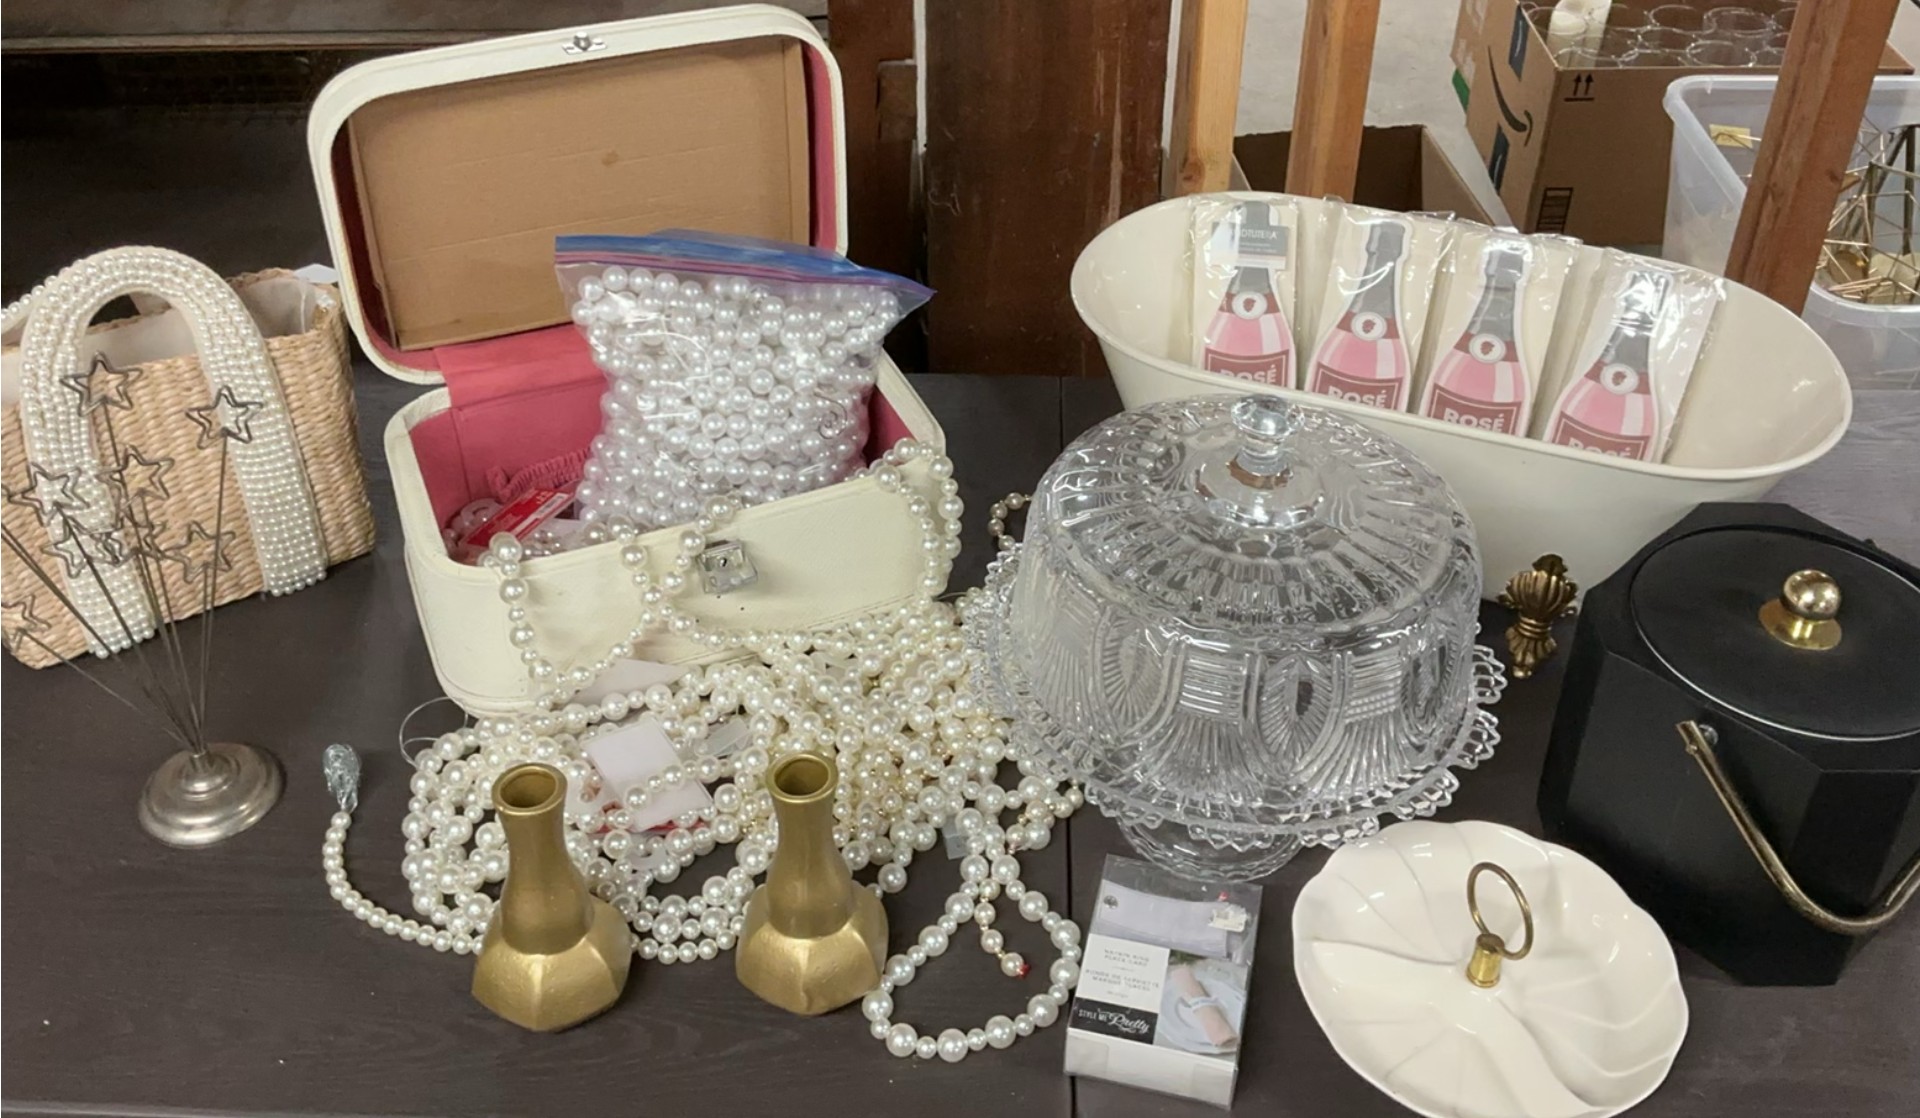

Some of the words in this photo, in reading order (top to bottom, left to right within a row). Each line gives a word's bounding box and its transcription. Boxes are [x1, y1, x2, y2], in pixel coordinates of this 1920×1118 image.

[1328, 385, 1387, 408] ROSÉ
[1443, 407, 1505, 432] ROSÉ
[1078, 1008, 1097, 1020] STYLE
[1107, 1012, 1150, 1034] Pretty
